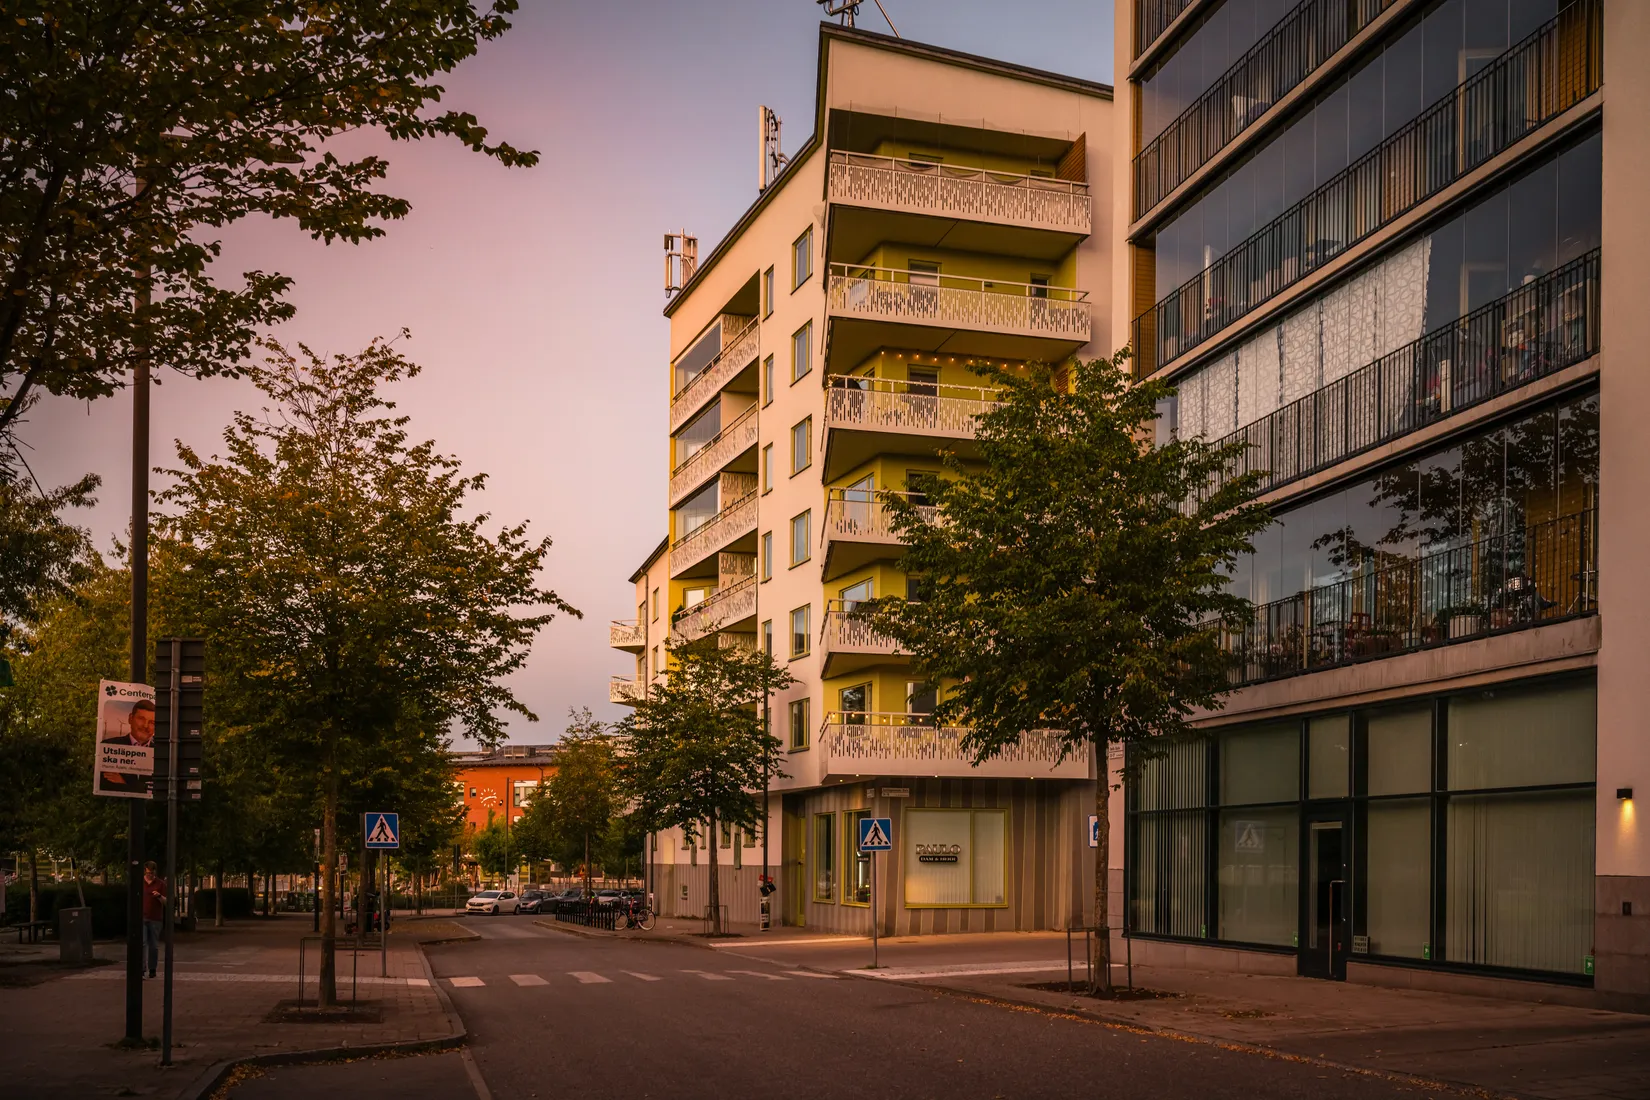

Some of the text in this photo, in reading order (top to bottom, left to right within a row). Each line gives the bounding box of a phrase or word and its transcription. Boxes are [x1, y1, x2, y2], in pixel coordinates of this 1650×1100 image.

[103, 747, 147, 758] Utsläppen
[102, 756, 118, 764] ska
[915, 843, 962, 855] PAULO
